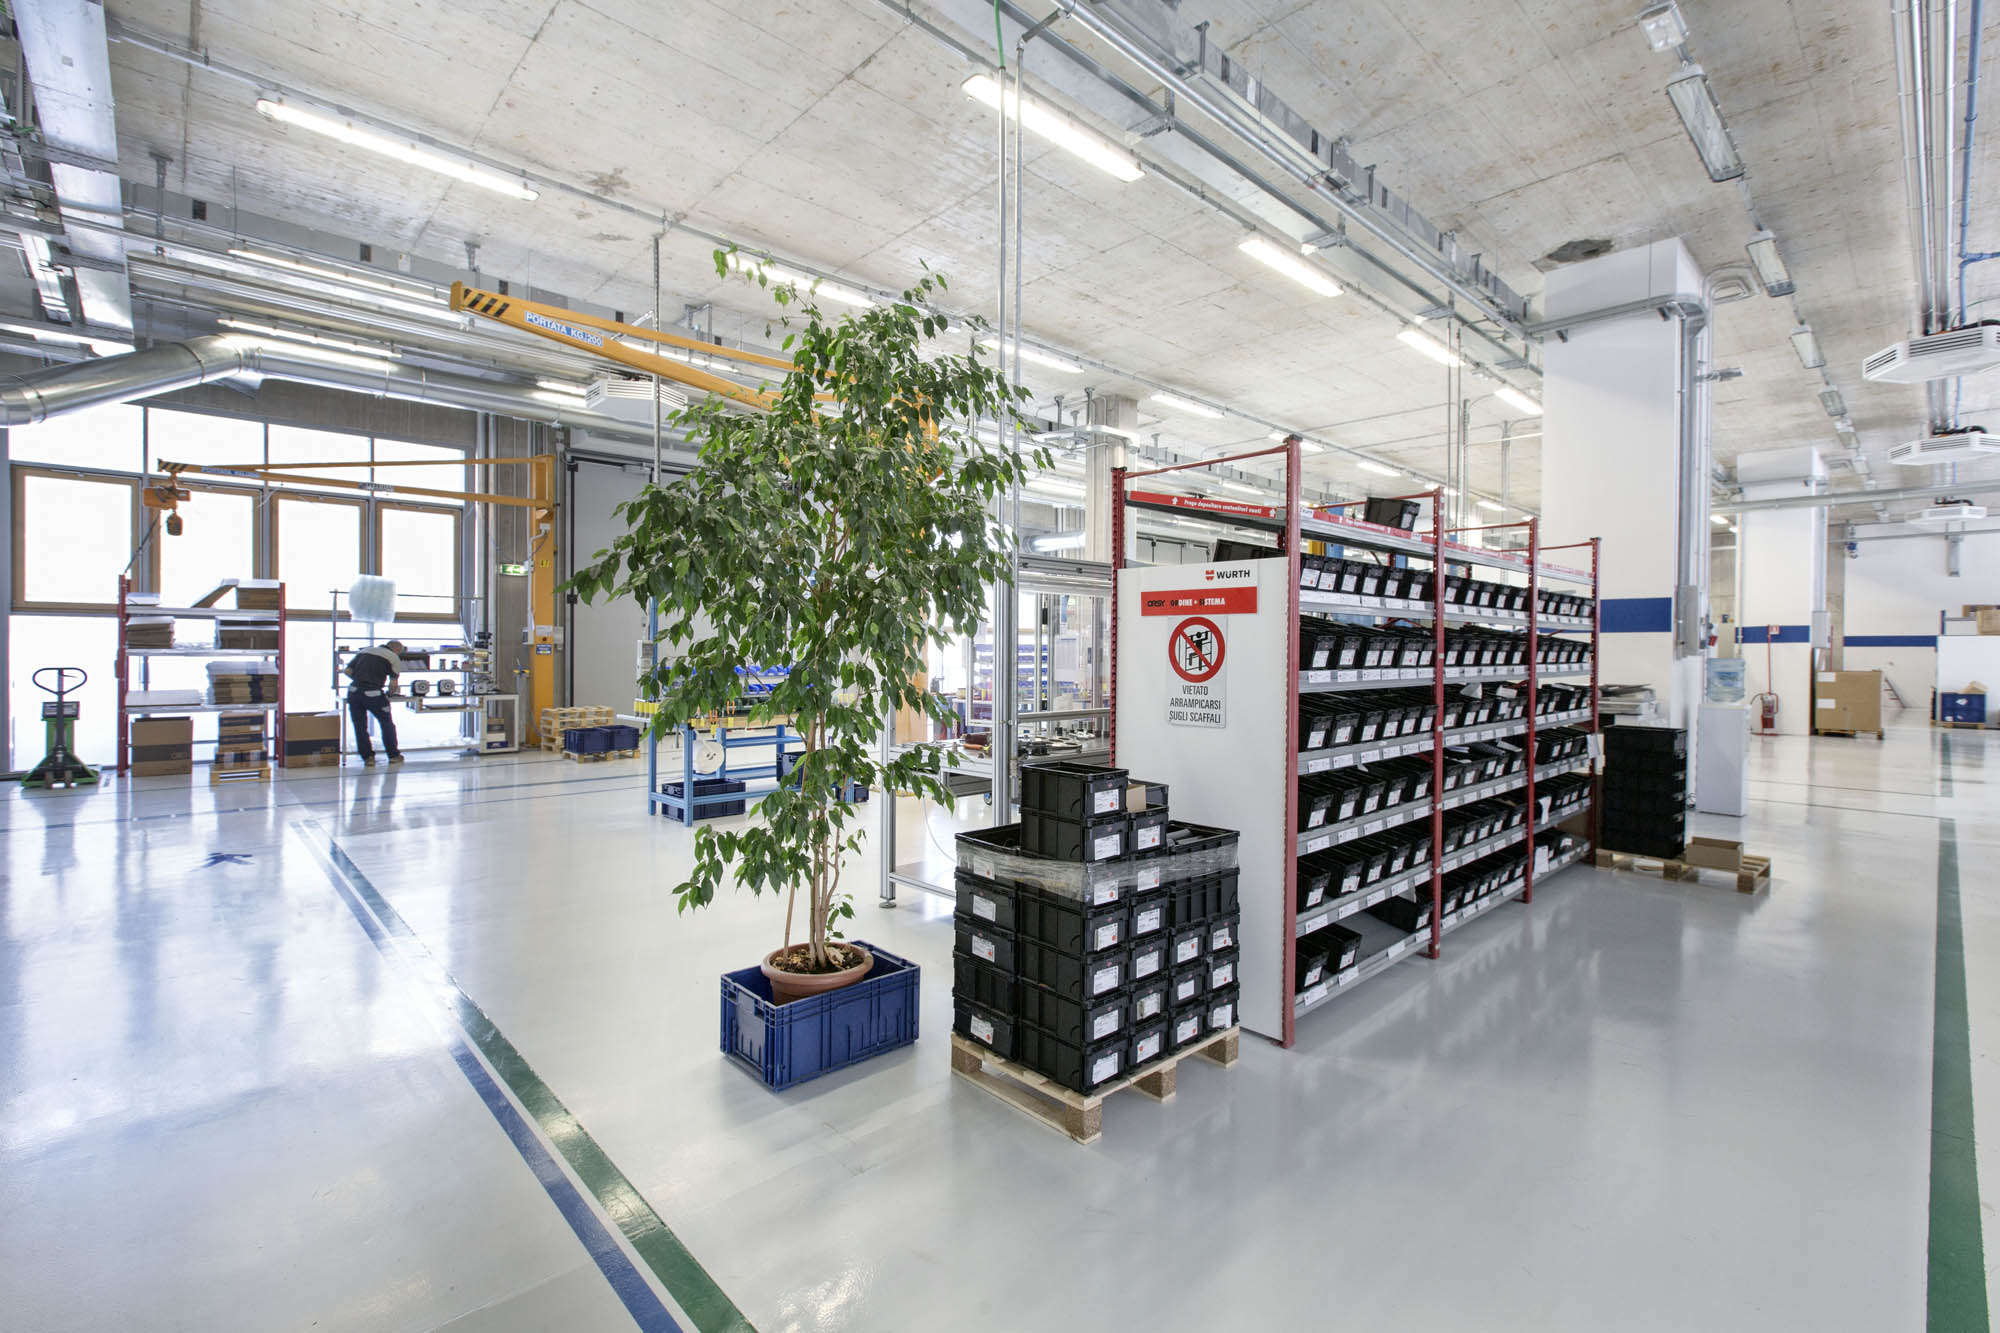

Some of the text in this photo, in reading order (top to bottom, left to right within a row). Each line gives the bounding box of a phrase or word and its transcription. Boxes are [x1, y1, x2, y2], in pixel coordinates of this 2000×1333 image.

[526, 311, 567, 334] PORTATA
[1216, 569, 1250, 580] WÜRTH
[1182, 685, 1208, 695] VIETATO
[1170, 697, 1221, 710] ARRAMPICARSI
[1169, 710, 1221, 723] SUGLI SCAFFALI
